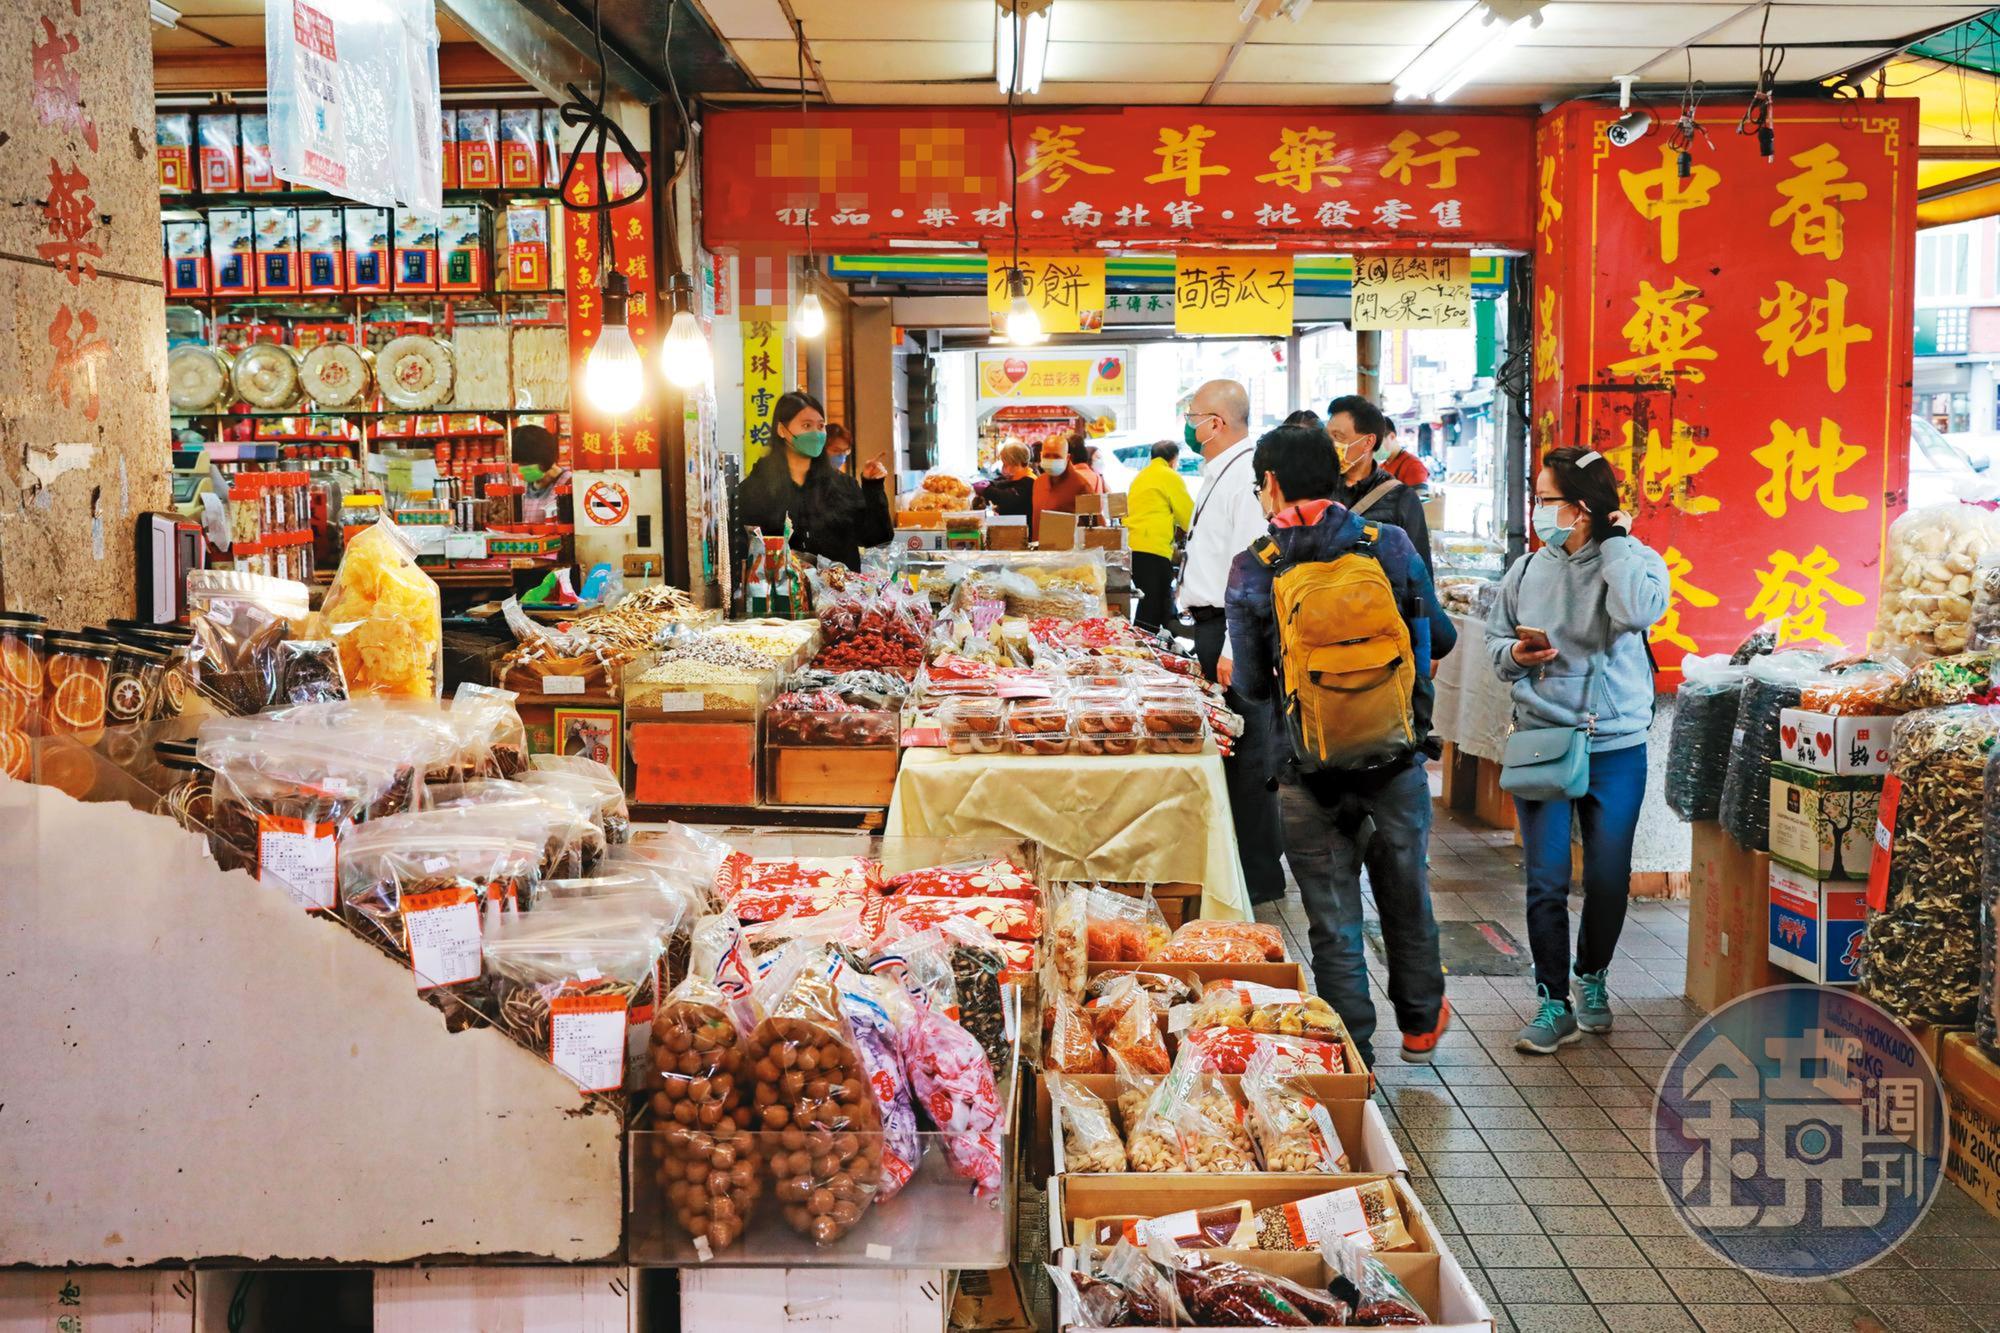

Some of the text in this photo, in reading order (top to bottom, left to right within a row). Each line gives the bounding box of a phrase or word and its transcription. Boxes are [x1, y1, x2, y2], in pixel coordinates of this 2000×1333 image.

[1177, 264, 1294, 311] 茴香瓜子
[1746, 142, 1872, 648] 香料批發
